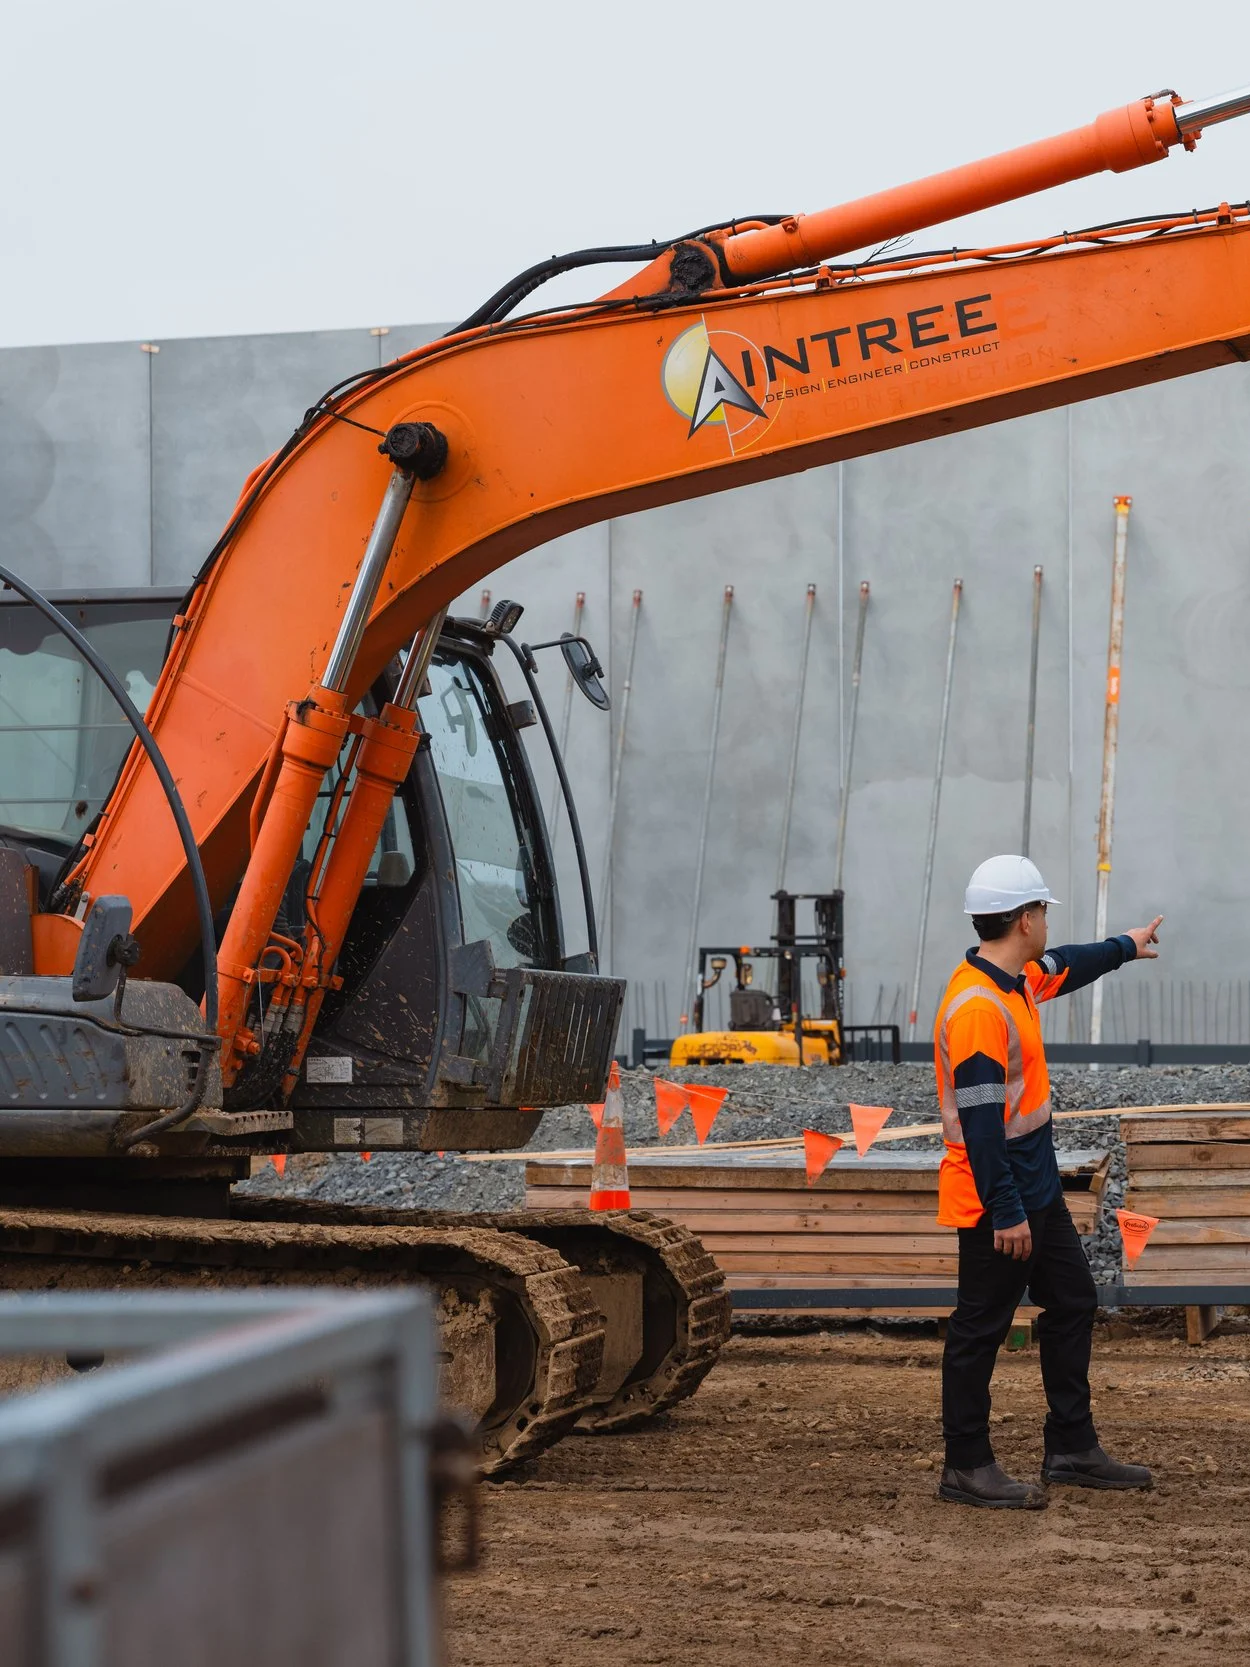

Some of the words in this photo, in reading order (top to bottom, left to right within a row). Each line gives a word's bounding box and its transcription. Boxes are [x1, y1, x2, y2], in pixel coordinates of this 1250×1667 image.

[765, 383, 821, 403] DESIGN
[827, 364, 903, 389] ENGINEER
[909, 341, 1001, 370] CONSTRUCT
